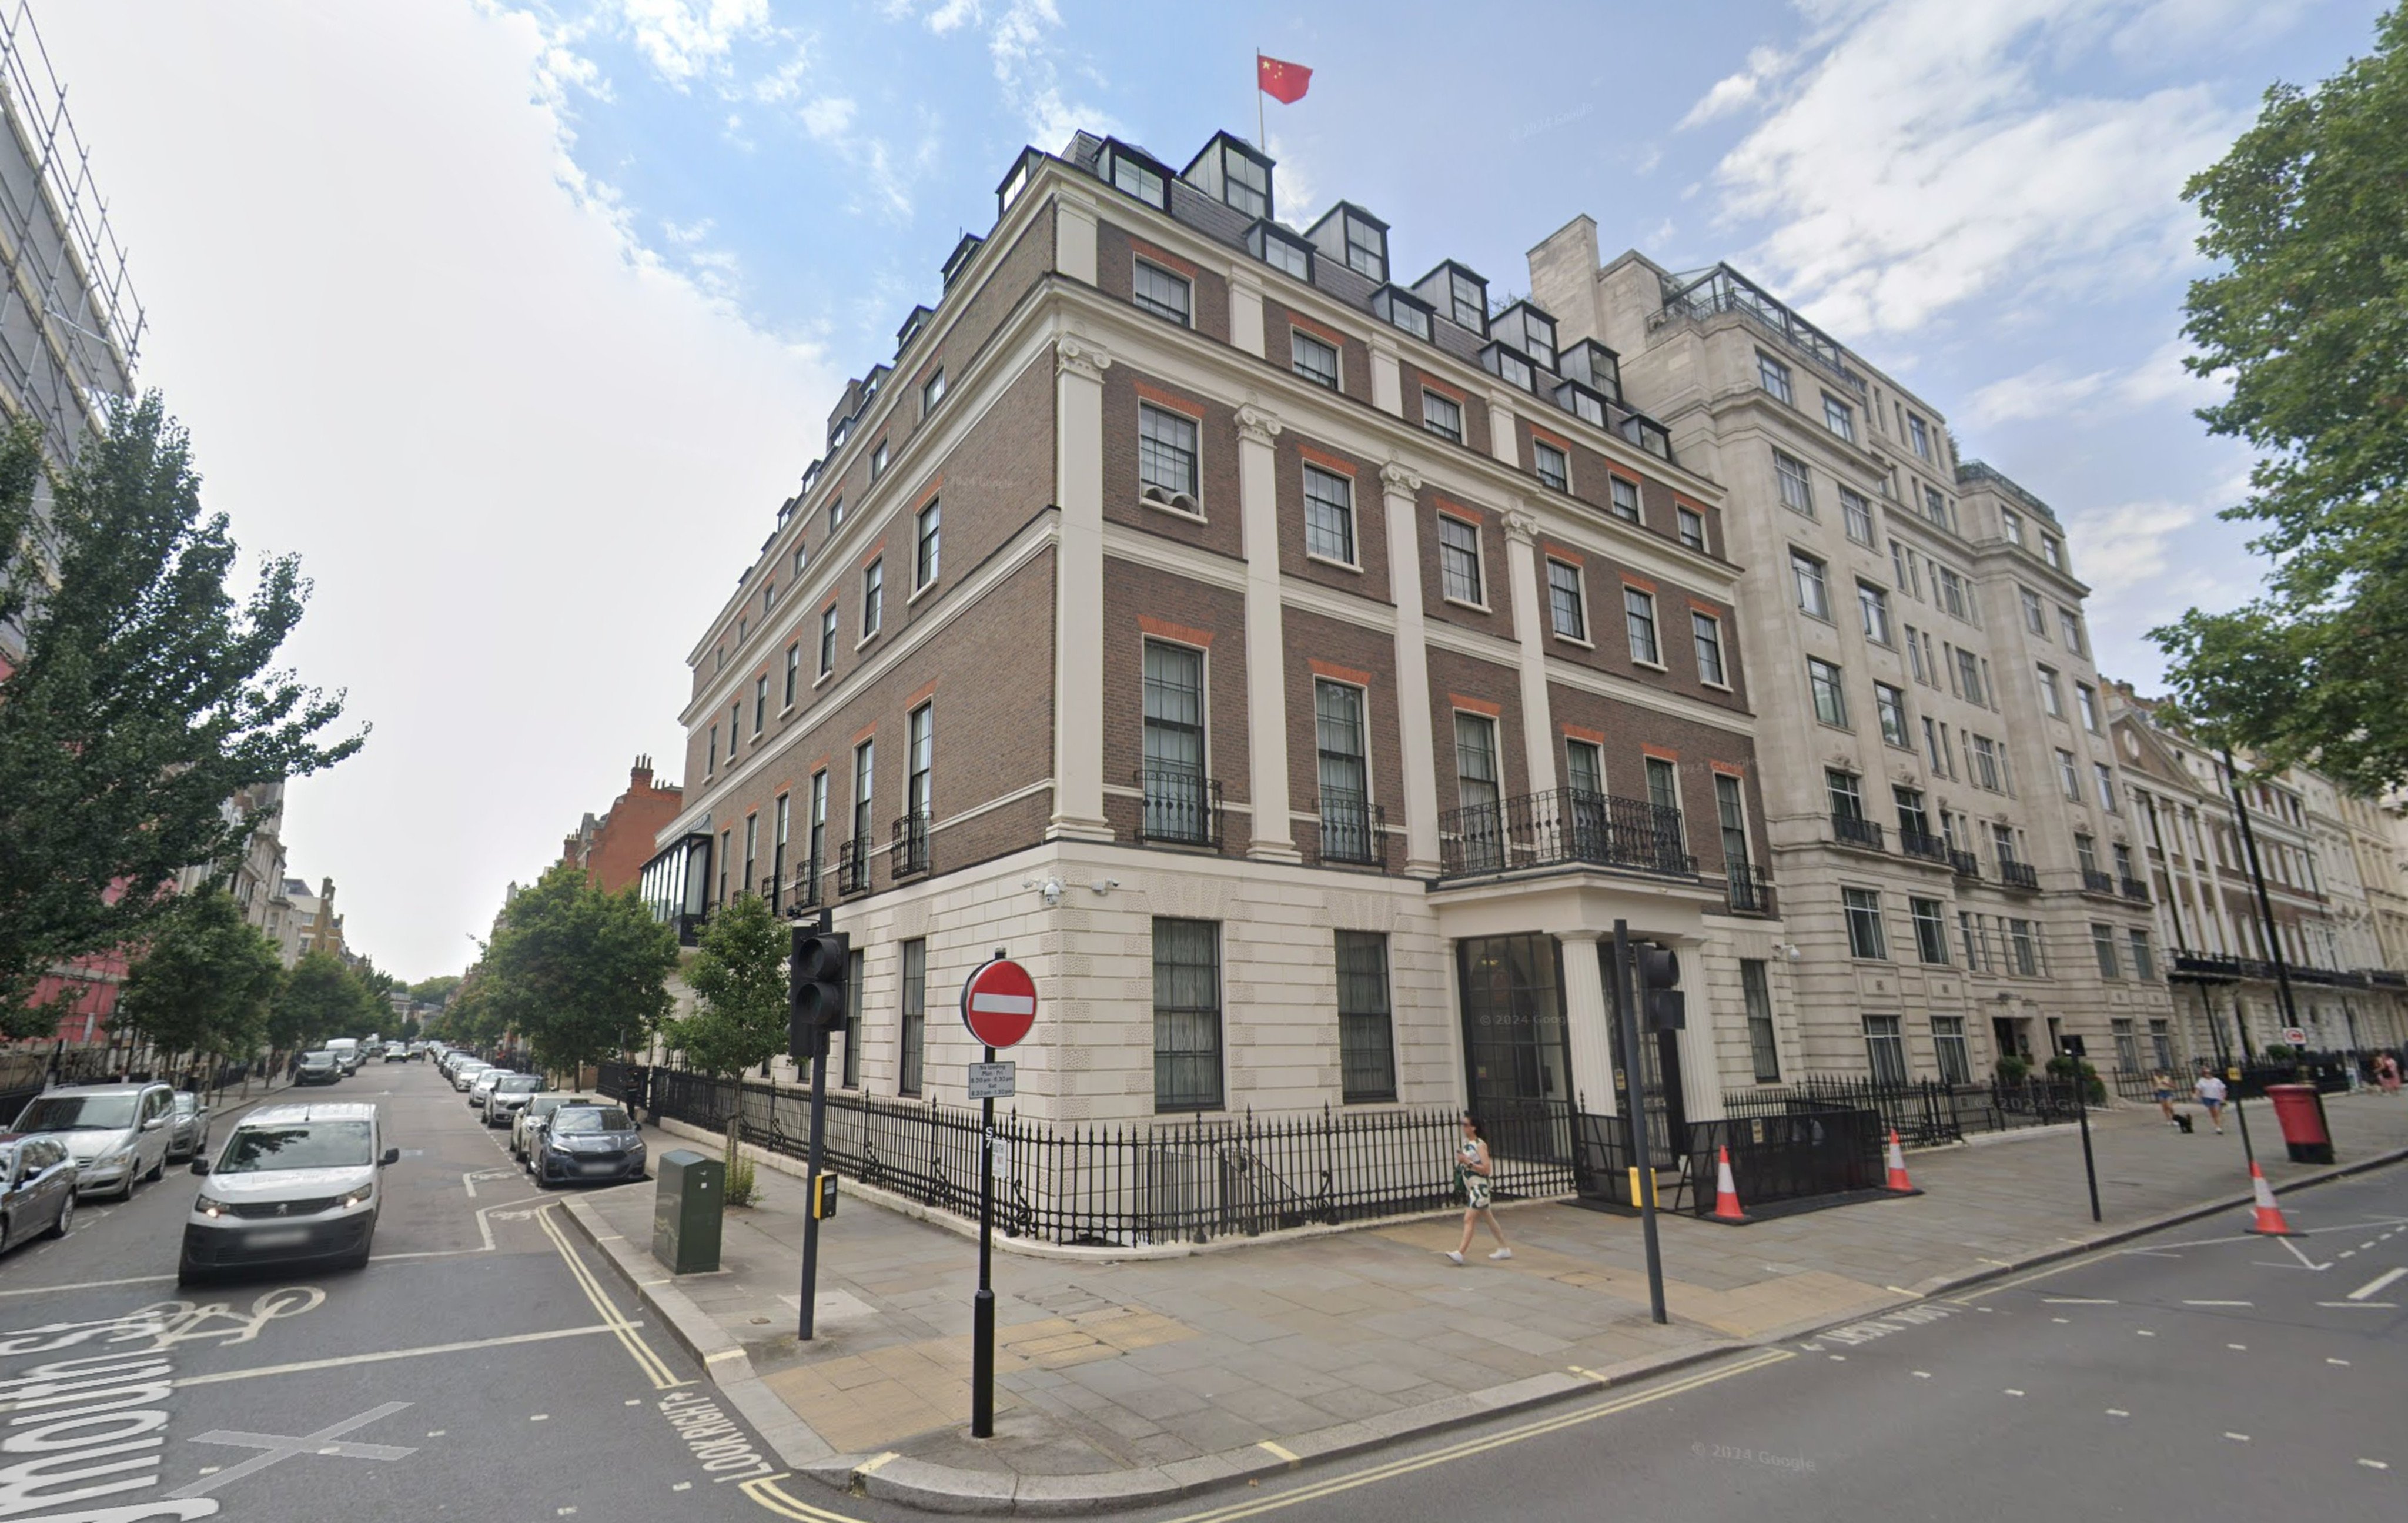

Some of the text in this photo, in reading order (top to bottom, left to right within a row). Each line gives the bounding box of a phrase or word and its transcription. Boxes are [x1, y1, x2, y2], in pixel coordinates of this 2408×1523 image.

[985, 1126, 993, 1138] S
[985, 1138, 992, 1149] 7
[657, 1397, 774, 1483] LOOK RIGHT
